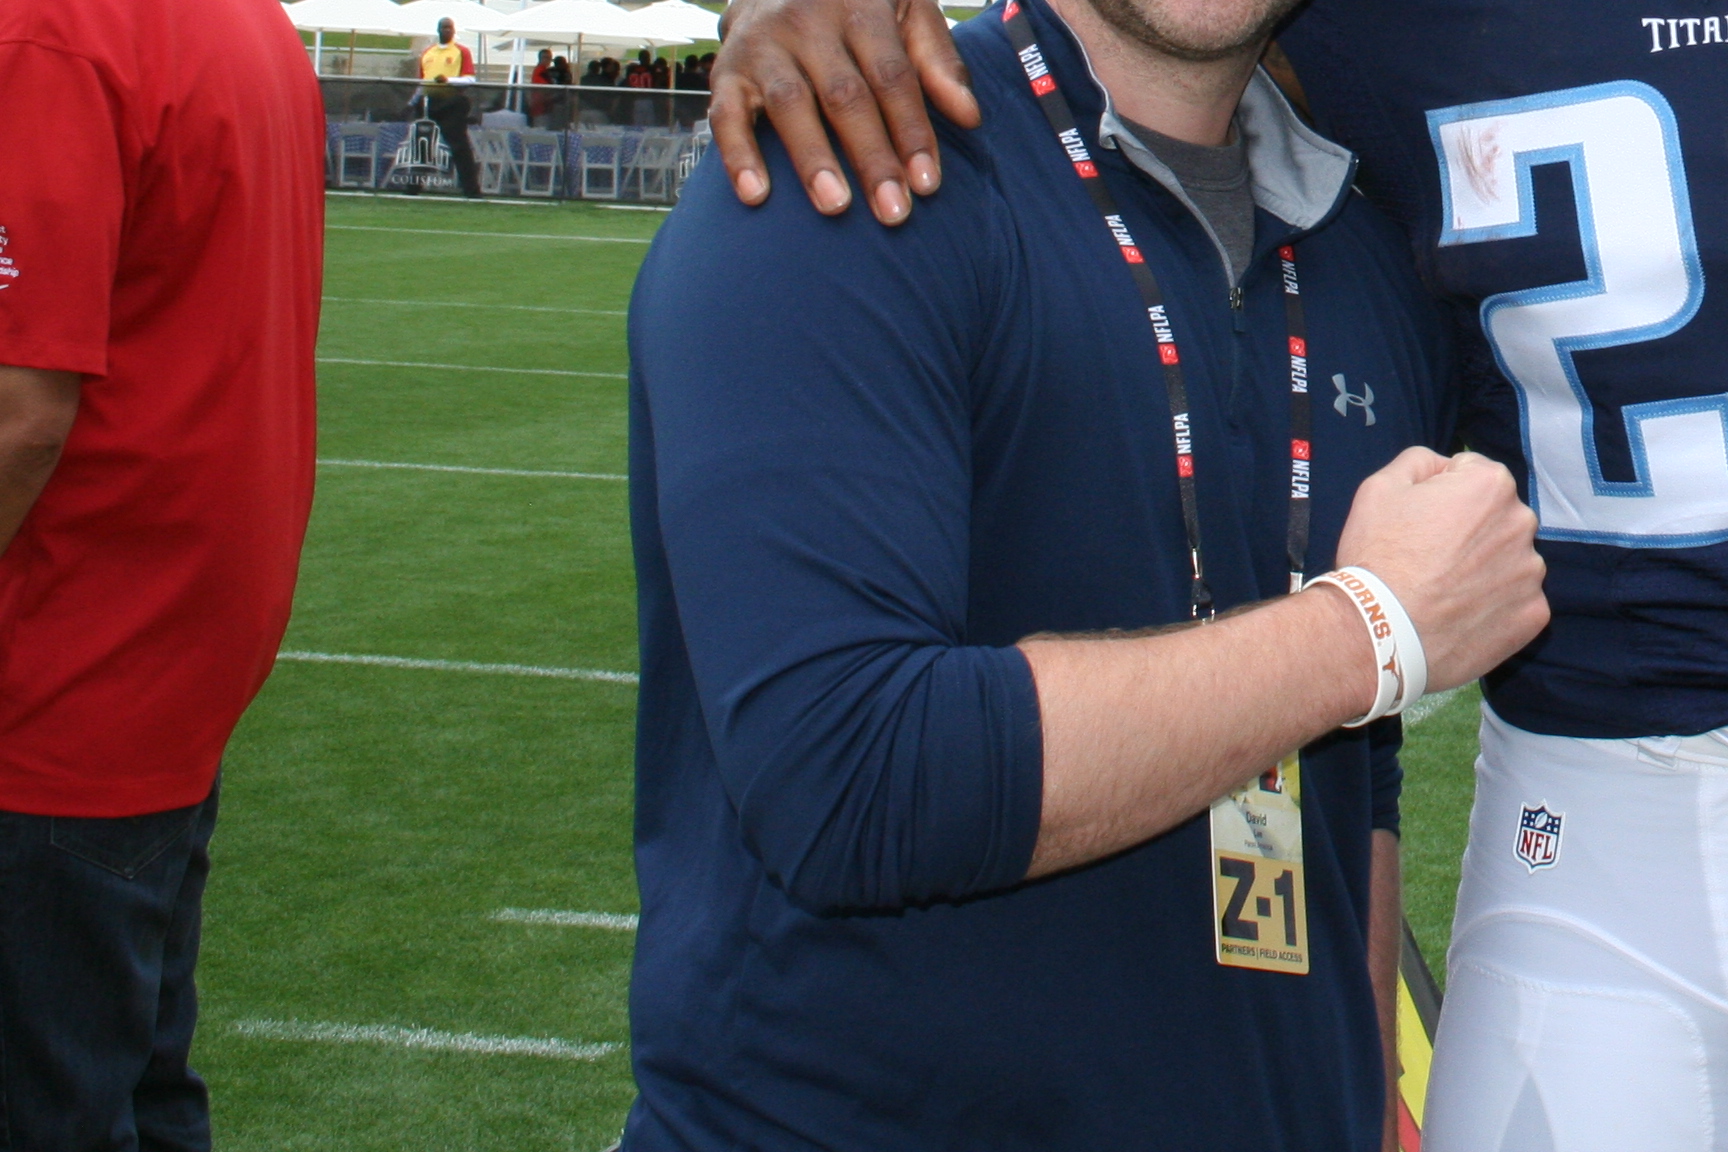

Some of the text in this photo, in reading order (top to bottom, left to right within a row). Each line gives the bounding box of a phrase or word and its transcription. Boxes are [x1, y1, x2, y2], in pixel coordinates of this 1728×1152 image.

[1018, 43, 1050, 81] NFLPA
[1058, 127, 1091, 163] NFLPA
[391, 174, 453, 187] COLISEUM
[1105, 214, 1136, 247] NFLPA
[1281, 259, 1300, 295] NFLPA
[1147, 305, 1175, 344] NFLPA
[1290, 355, 1308, 394] NFLPA
[1173, 411, 1192, 455] NFLPA
[1290, 459, 1310, 499] NFLPA
[1332, 571, 1391, 639] HORNS
[1519, 829, 1553, 862] NFL
[1260, 948, 1278, 959] FIELD
[1279, 951, 1302, 963] ACCESS
